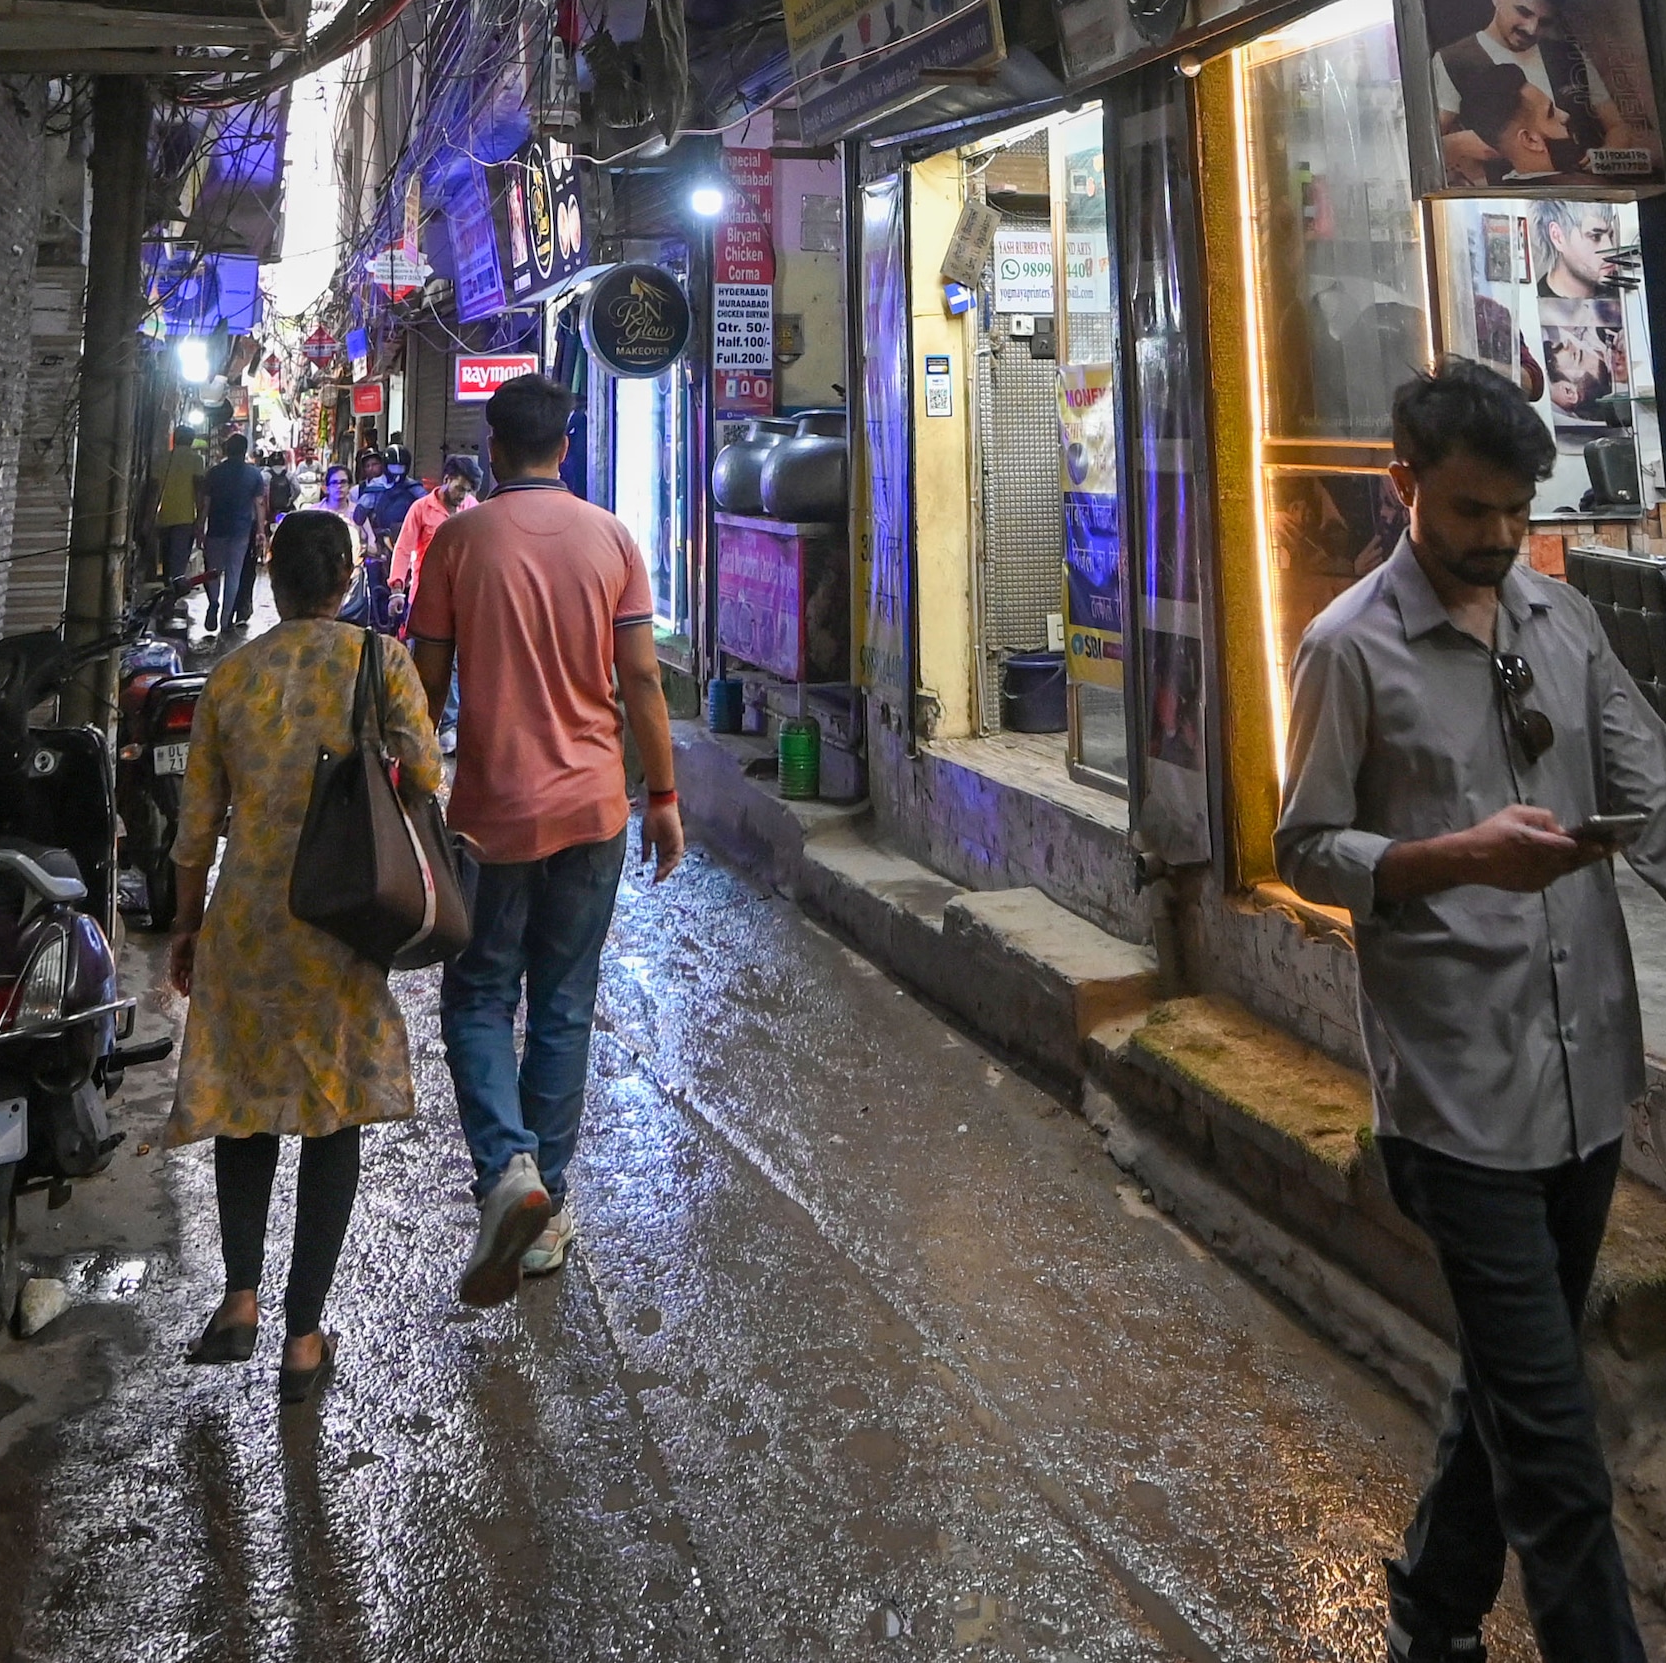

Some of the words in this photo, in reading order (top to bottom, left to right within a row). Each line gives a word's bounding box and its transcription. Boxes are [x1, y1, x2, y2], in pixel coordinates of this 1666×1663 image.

[724, 246, 764, 263] Chicken
[999, 241, 1015, 255] YASH
[1016, 241, 1038, 254] RUBBER
[1077, 242, 1092, 254] ARTS
[728, 265, 761, 281] Corma
[718, 287, 769, 298] HYDERABADI
[718, 299, 770, 309] MURADABADI
[717, 309, 745, 319] CHICKEN
[717, 321, 743, 334] Qtr.
[746, 321, 770, 333] 50/-
[717, 336, 771, 348] Half.100/-
[616, 346, 670, 356] MAKEOVER
[717, 352, 769, 365] Full.200/-
[1085, 637, 1102, 659] SBI
